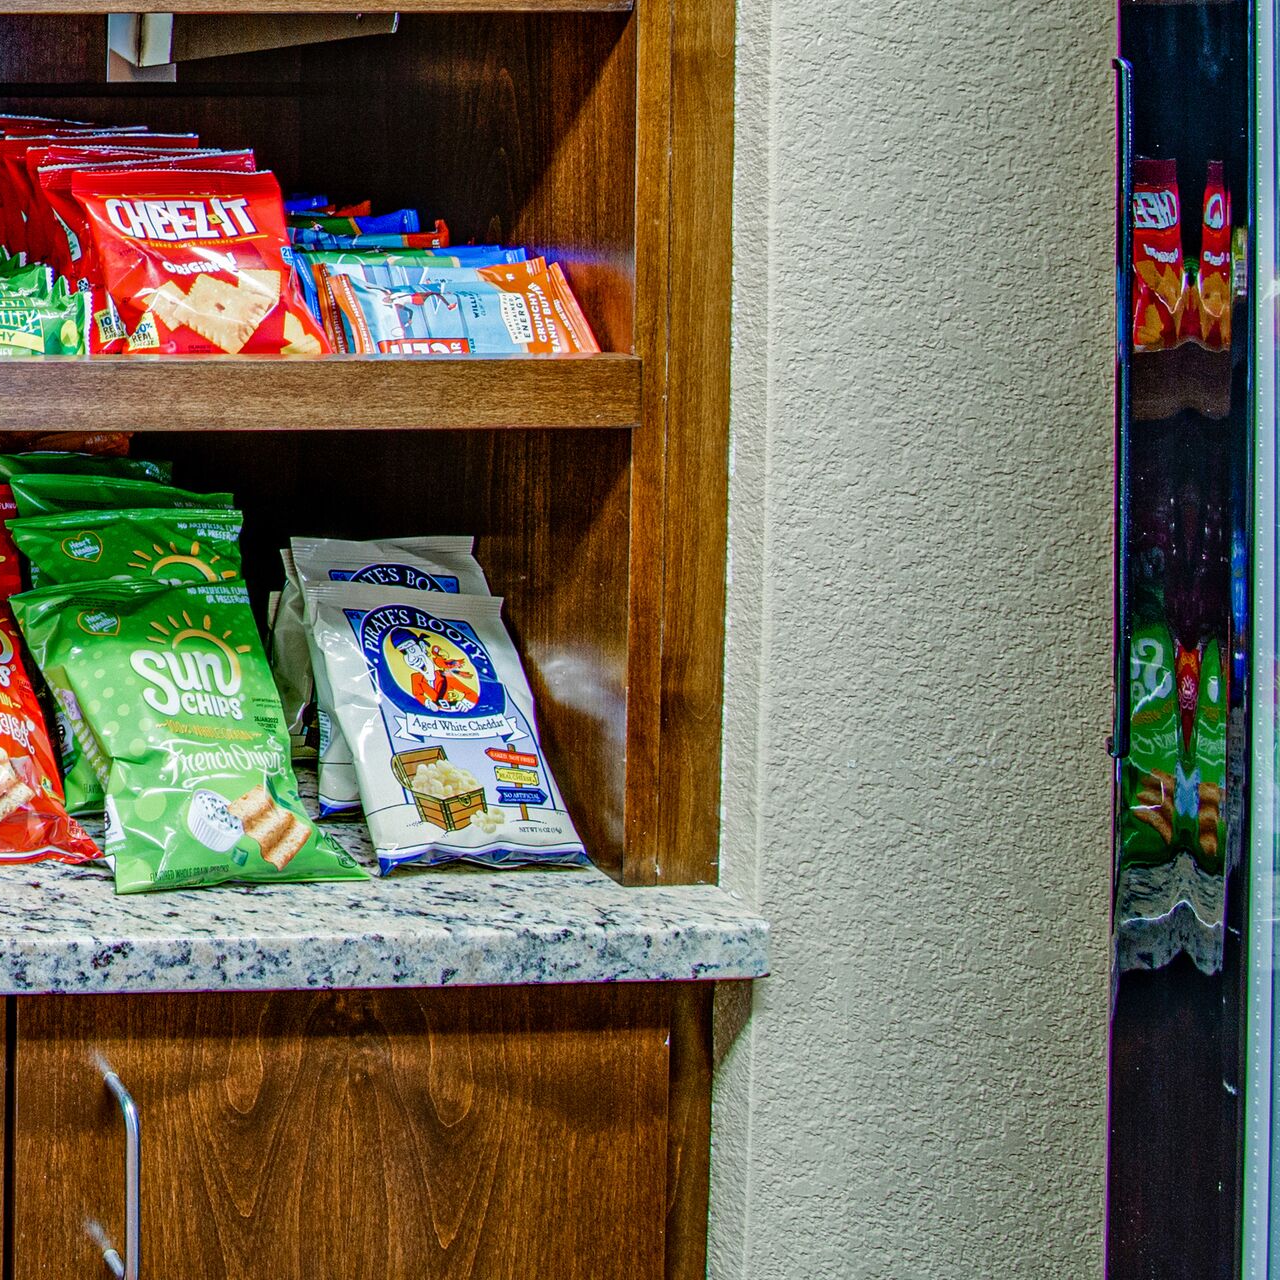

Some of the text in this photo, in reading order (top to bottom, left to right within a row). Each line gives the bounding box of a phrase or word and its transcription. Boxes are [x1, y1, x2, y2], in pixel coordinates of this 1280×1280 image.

[514, 294, 532, 339] ENERGY
[526, 290, 548, 343] CRUNCHY
[68, 536, 92, 550] Heart
[71, 544, 100, 559] Healthy
[85, 609, 108, 624] Heart
[363, 607, 490, 666] PIRATE'S BOOTY
[129, 646, 242, 717] Sun
[184, 694, 244, 721] CHIPS
[412, 717, 505, 732] Aged White Cheddar
